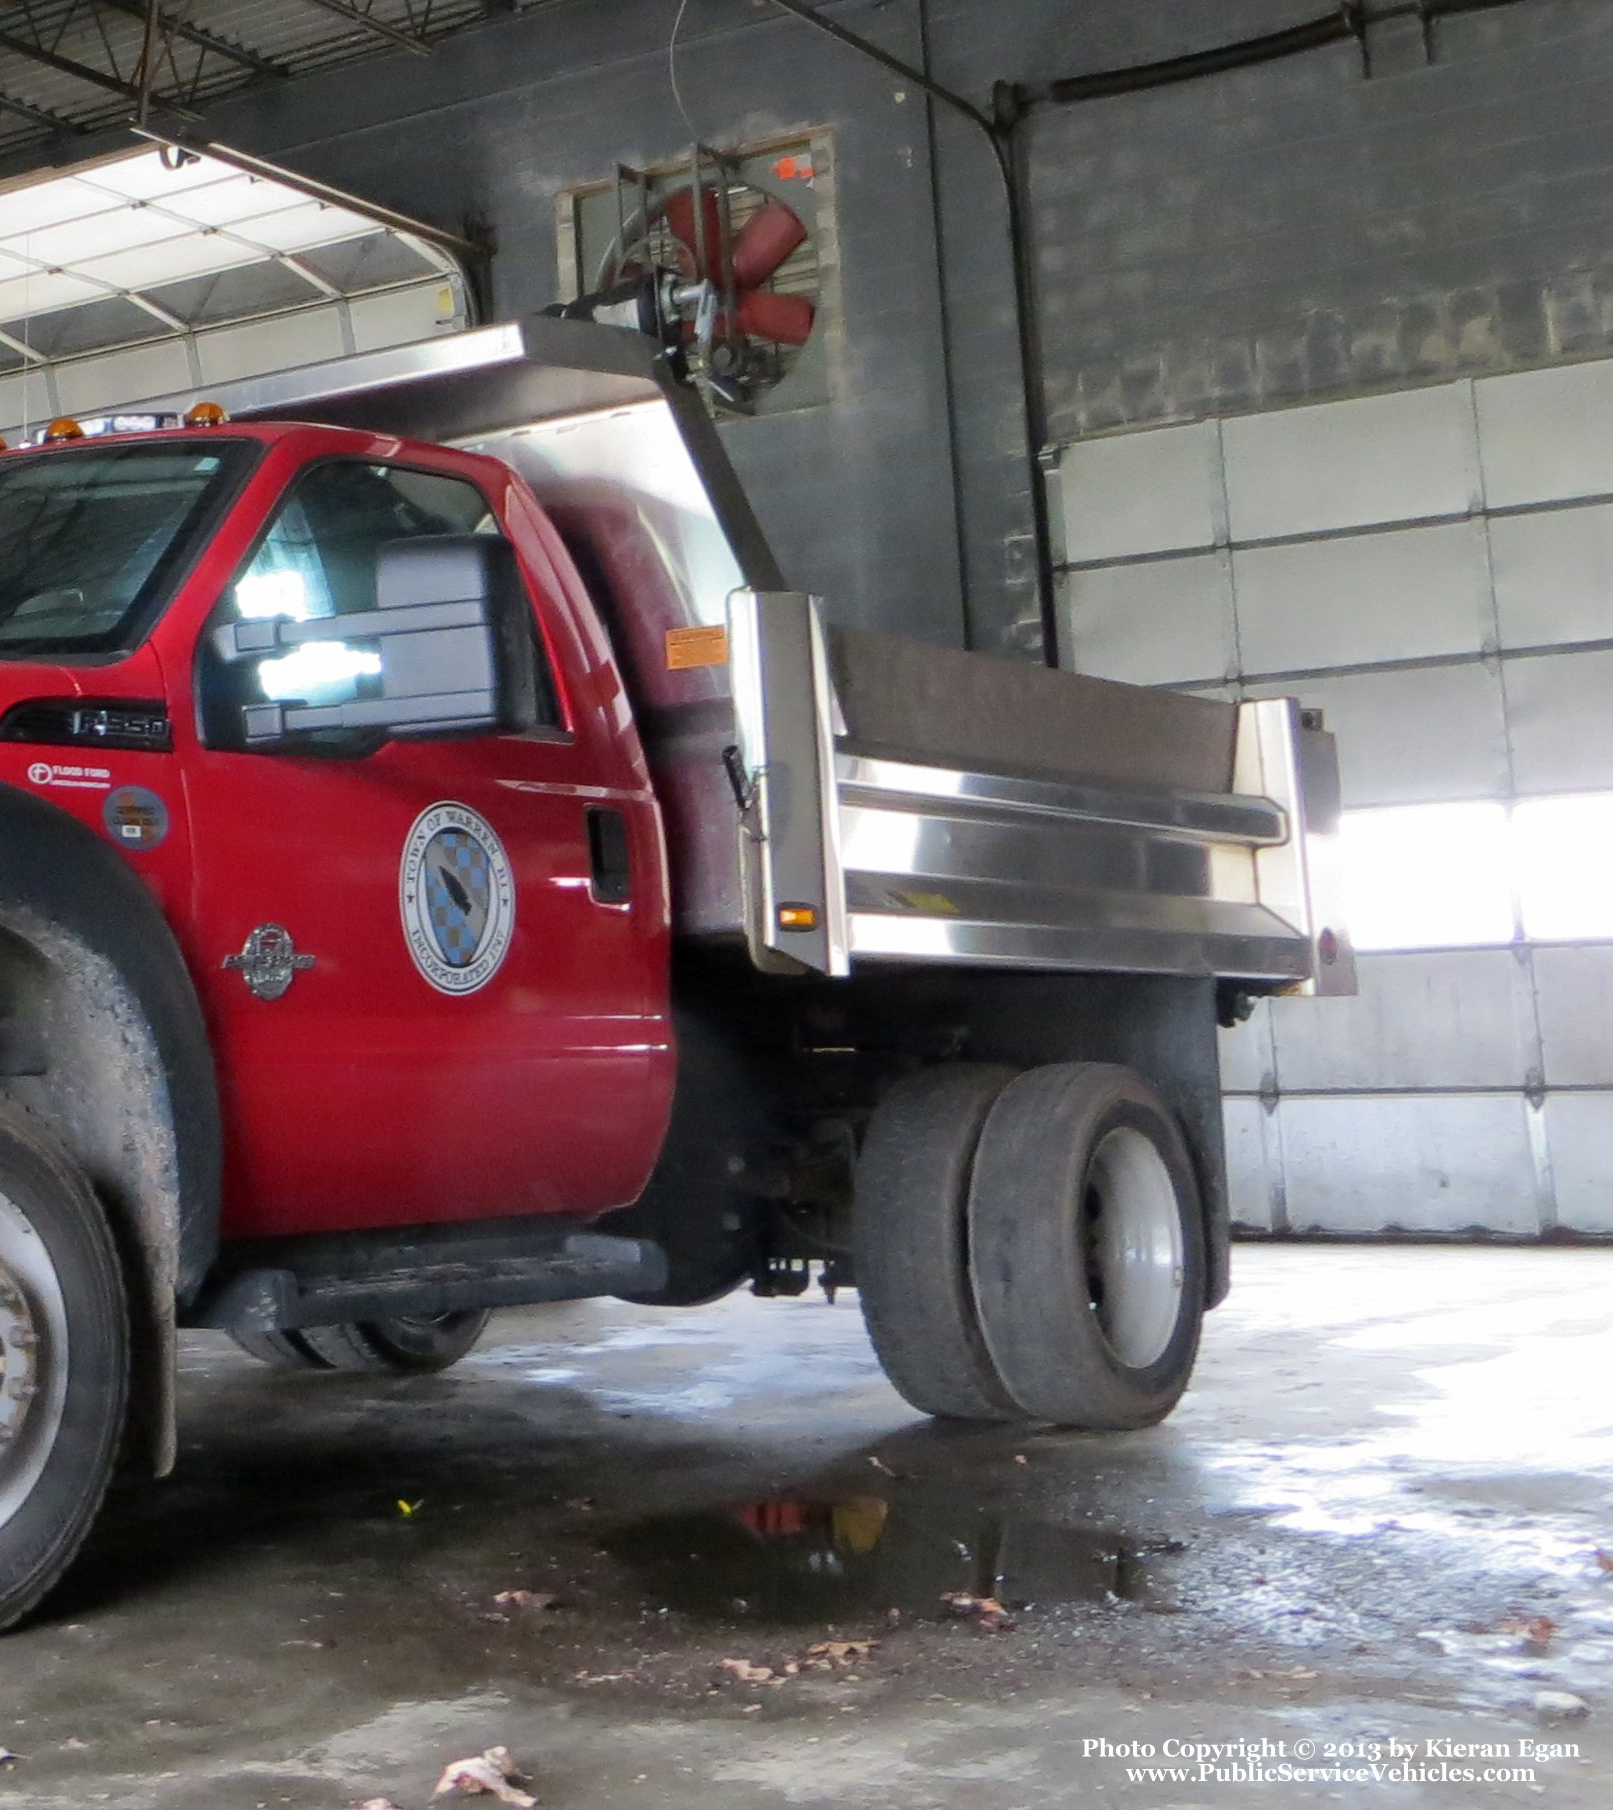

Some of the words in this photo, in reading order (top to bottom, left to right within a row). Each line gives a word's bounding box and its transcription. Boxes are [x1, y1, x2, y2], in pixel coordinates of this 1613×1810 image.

[84, 767, 111, 779] FORD
[405, 828, 427, 885] TOWN
[427, 812, 442, 832] OF
